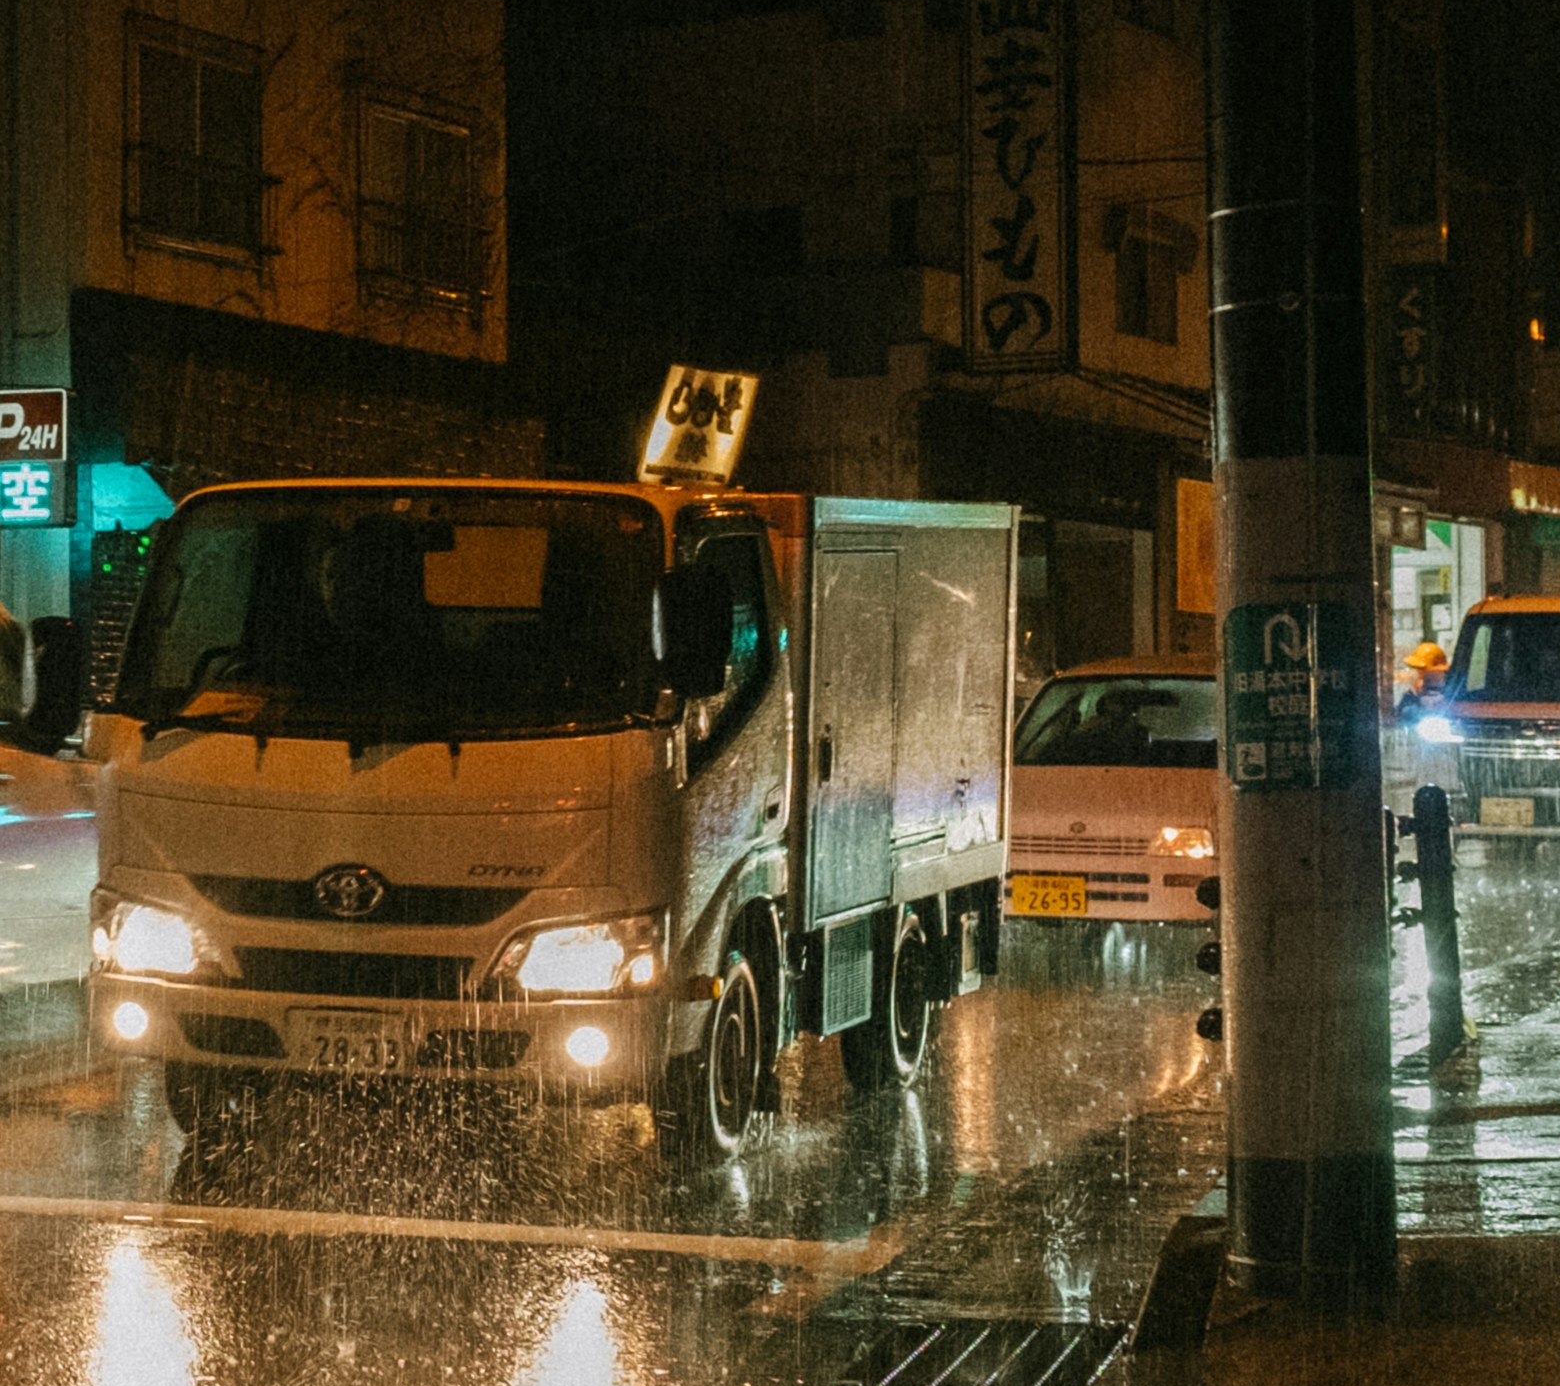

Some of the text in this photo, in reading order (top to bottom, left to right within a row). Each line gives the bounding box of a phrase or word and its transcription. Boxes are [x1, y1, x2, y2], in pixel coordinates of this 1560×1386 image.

[18, 424, 59, 451] 24H
[1, 463, 51, 519] 空
[1029, 891, 1081, 910] 26-95
